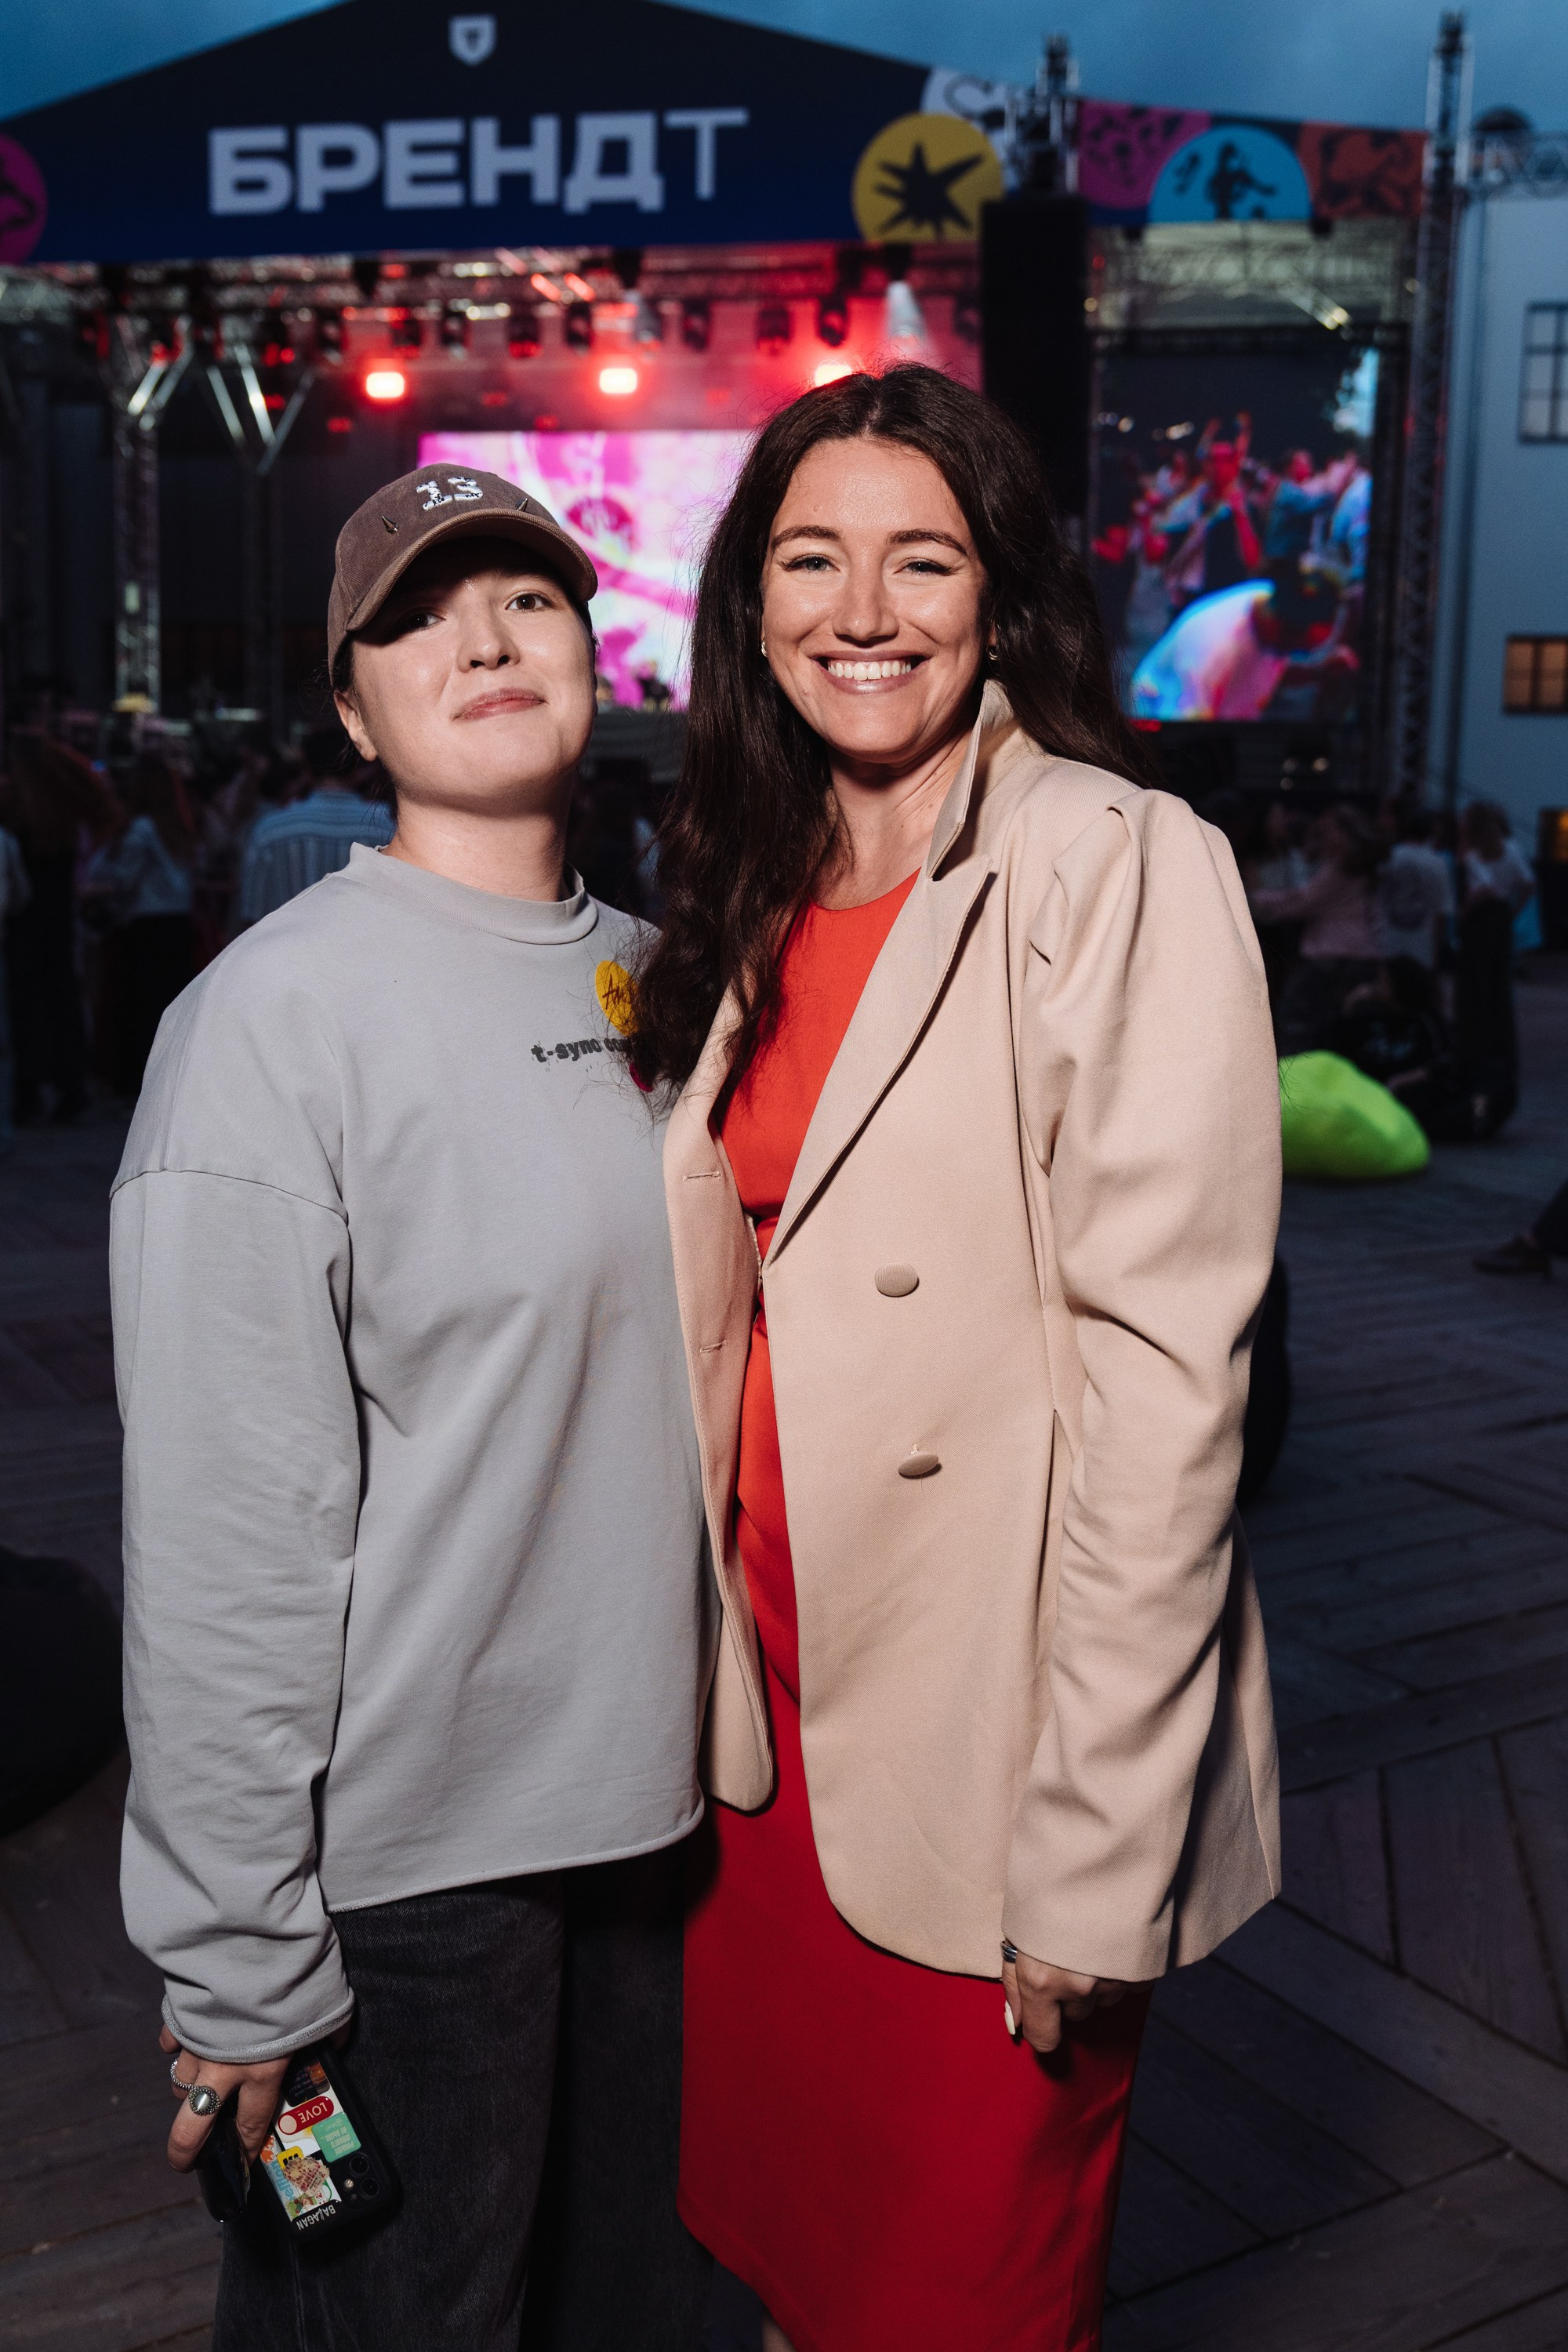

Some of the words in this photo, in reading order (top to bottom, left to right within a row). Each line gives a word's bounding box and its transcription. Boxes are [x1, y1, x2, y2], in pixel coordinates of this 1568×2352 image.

[416, 476, 483, 510] 13
[531, 1038, 602, 1062] t-sync
[299, 2101, 328, 2124] LOVE
[296, 2205, 336, 2230] BALAGAN
